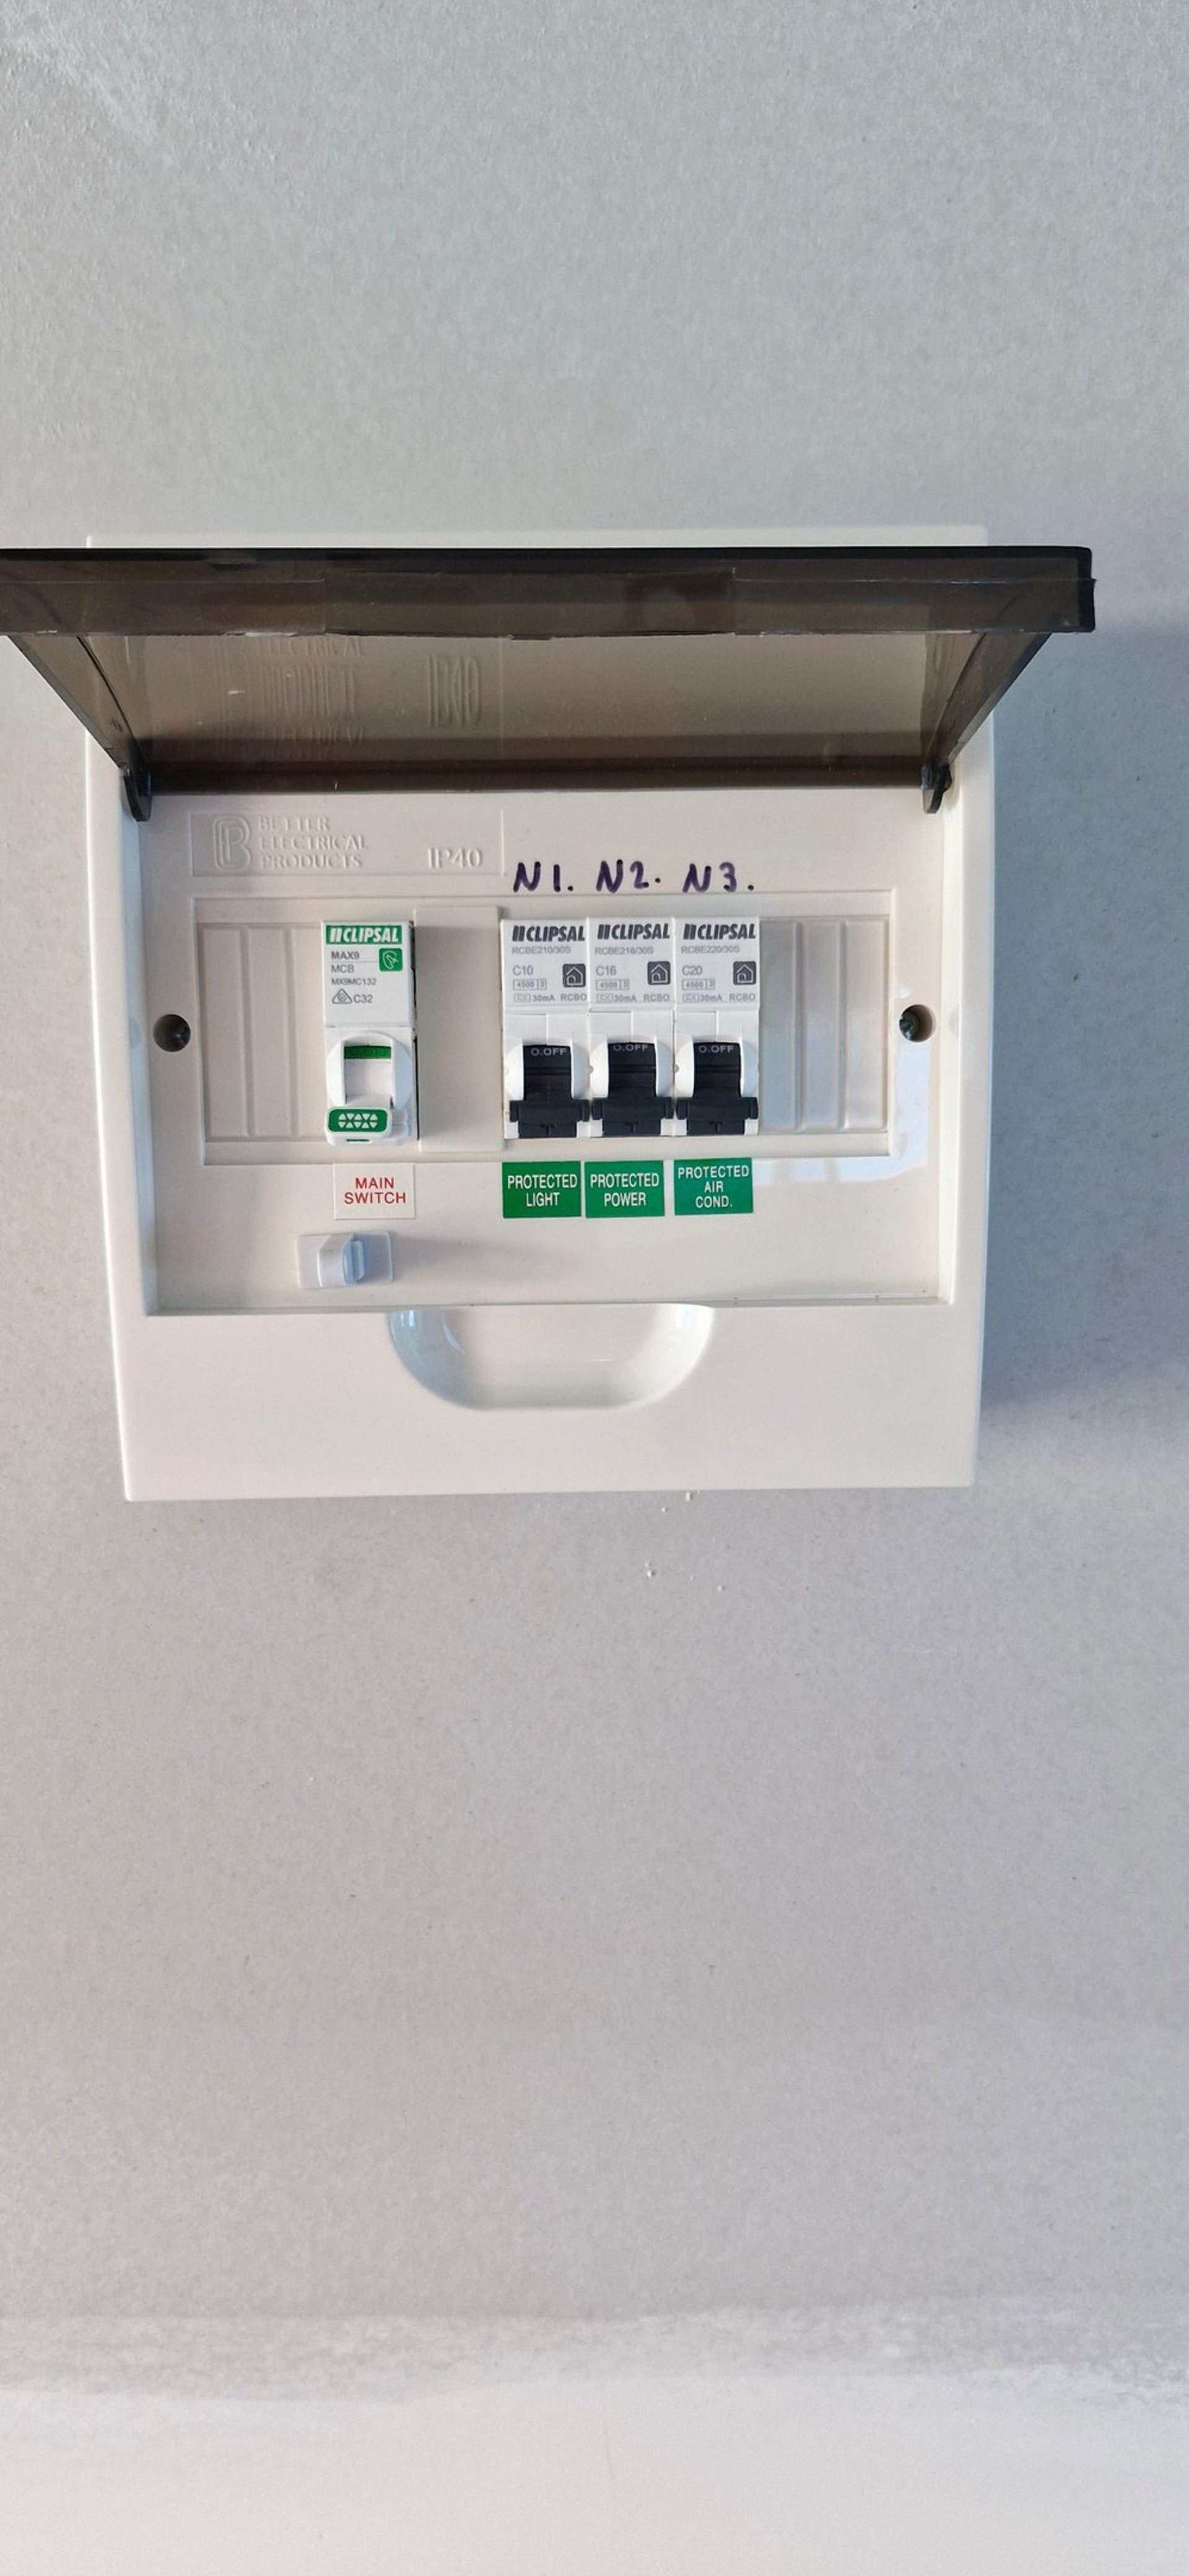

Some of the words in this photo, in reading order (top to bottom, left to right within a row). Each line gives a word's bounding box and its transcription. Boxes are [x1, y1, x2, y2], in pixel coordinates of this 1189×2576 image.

[259, 834, 368, 850] ELECTRICAL
[259, 854, 363, 869] PRODUCTS
[427, 847, 482, 867] IP40
[343, 927, 399, 943] CLIPSAL
[526, 925, 585, 941] CLIPSAL
[611, 923, 670, 940] CLIPSAL
[697, 923, 756, 940] CLIPSAL
[331, 951, 360, 960] MAX9
[331, 964, 354, 973] MCB
[512, 965, 533, 976] C10
[596, 965, 617, 976] C16
[682, 965, 702, 976] C20
[354, 994, 373, 1003] C32
[533, 994, 555, 1002] 30mA
[560, 993, 587, 1001] RCBO
[643, 993, 670, 1002] RCBO
[730, 993, 756, 1001] RCBO
[678, 1165, 749, 1179] PROTECTED
[355, 1177, 394, 1189] MAIN
[507, 1174, 577, 1189] PROTECTED
[590, 1172, 659, 1188] PROTECTED
[704, 1181, 723, 1193] AIR
[344, 1192, 406, 1204] SWITCH
[526, 1192, 560, 1207] LIGHT
[604, 1192, 646, 1207] POWER
[695, 1195, 733, 1208] COND.
